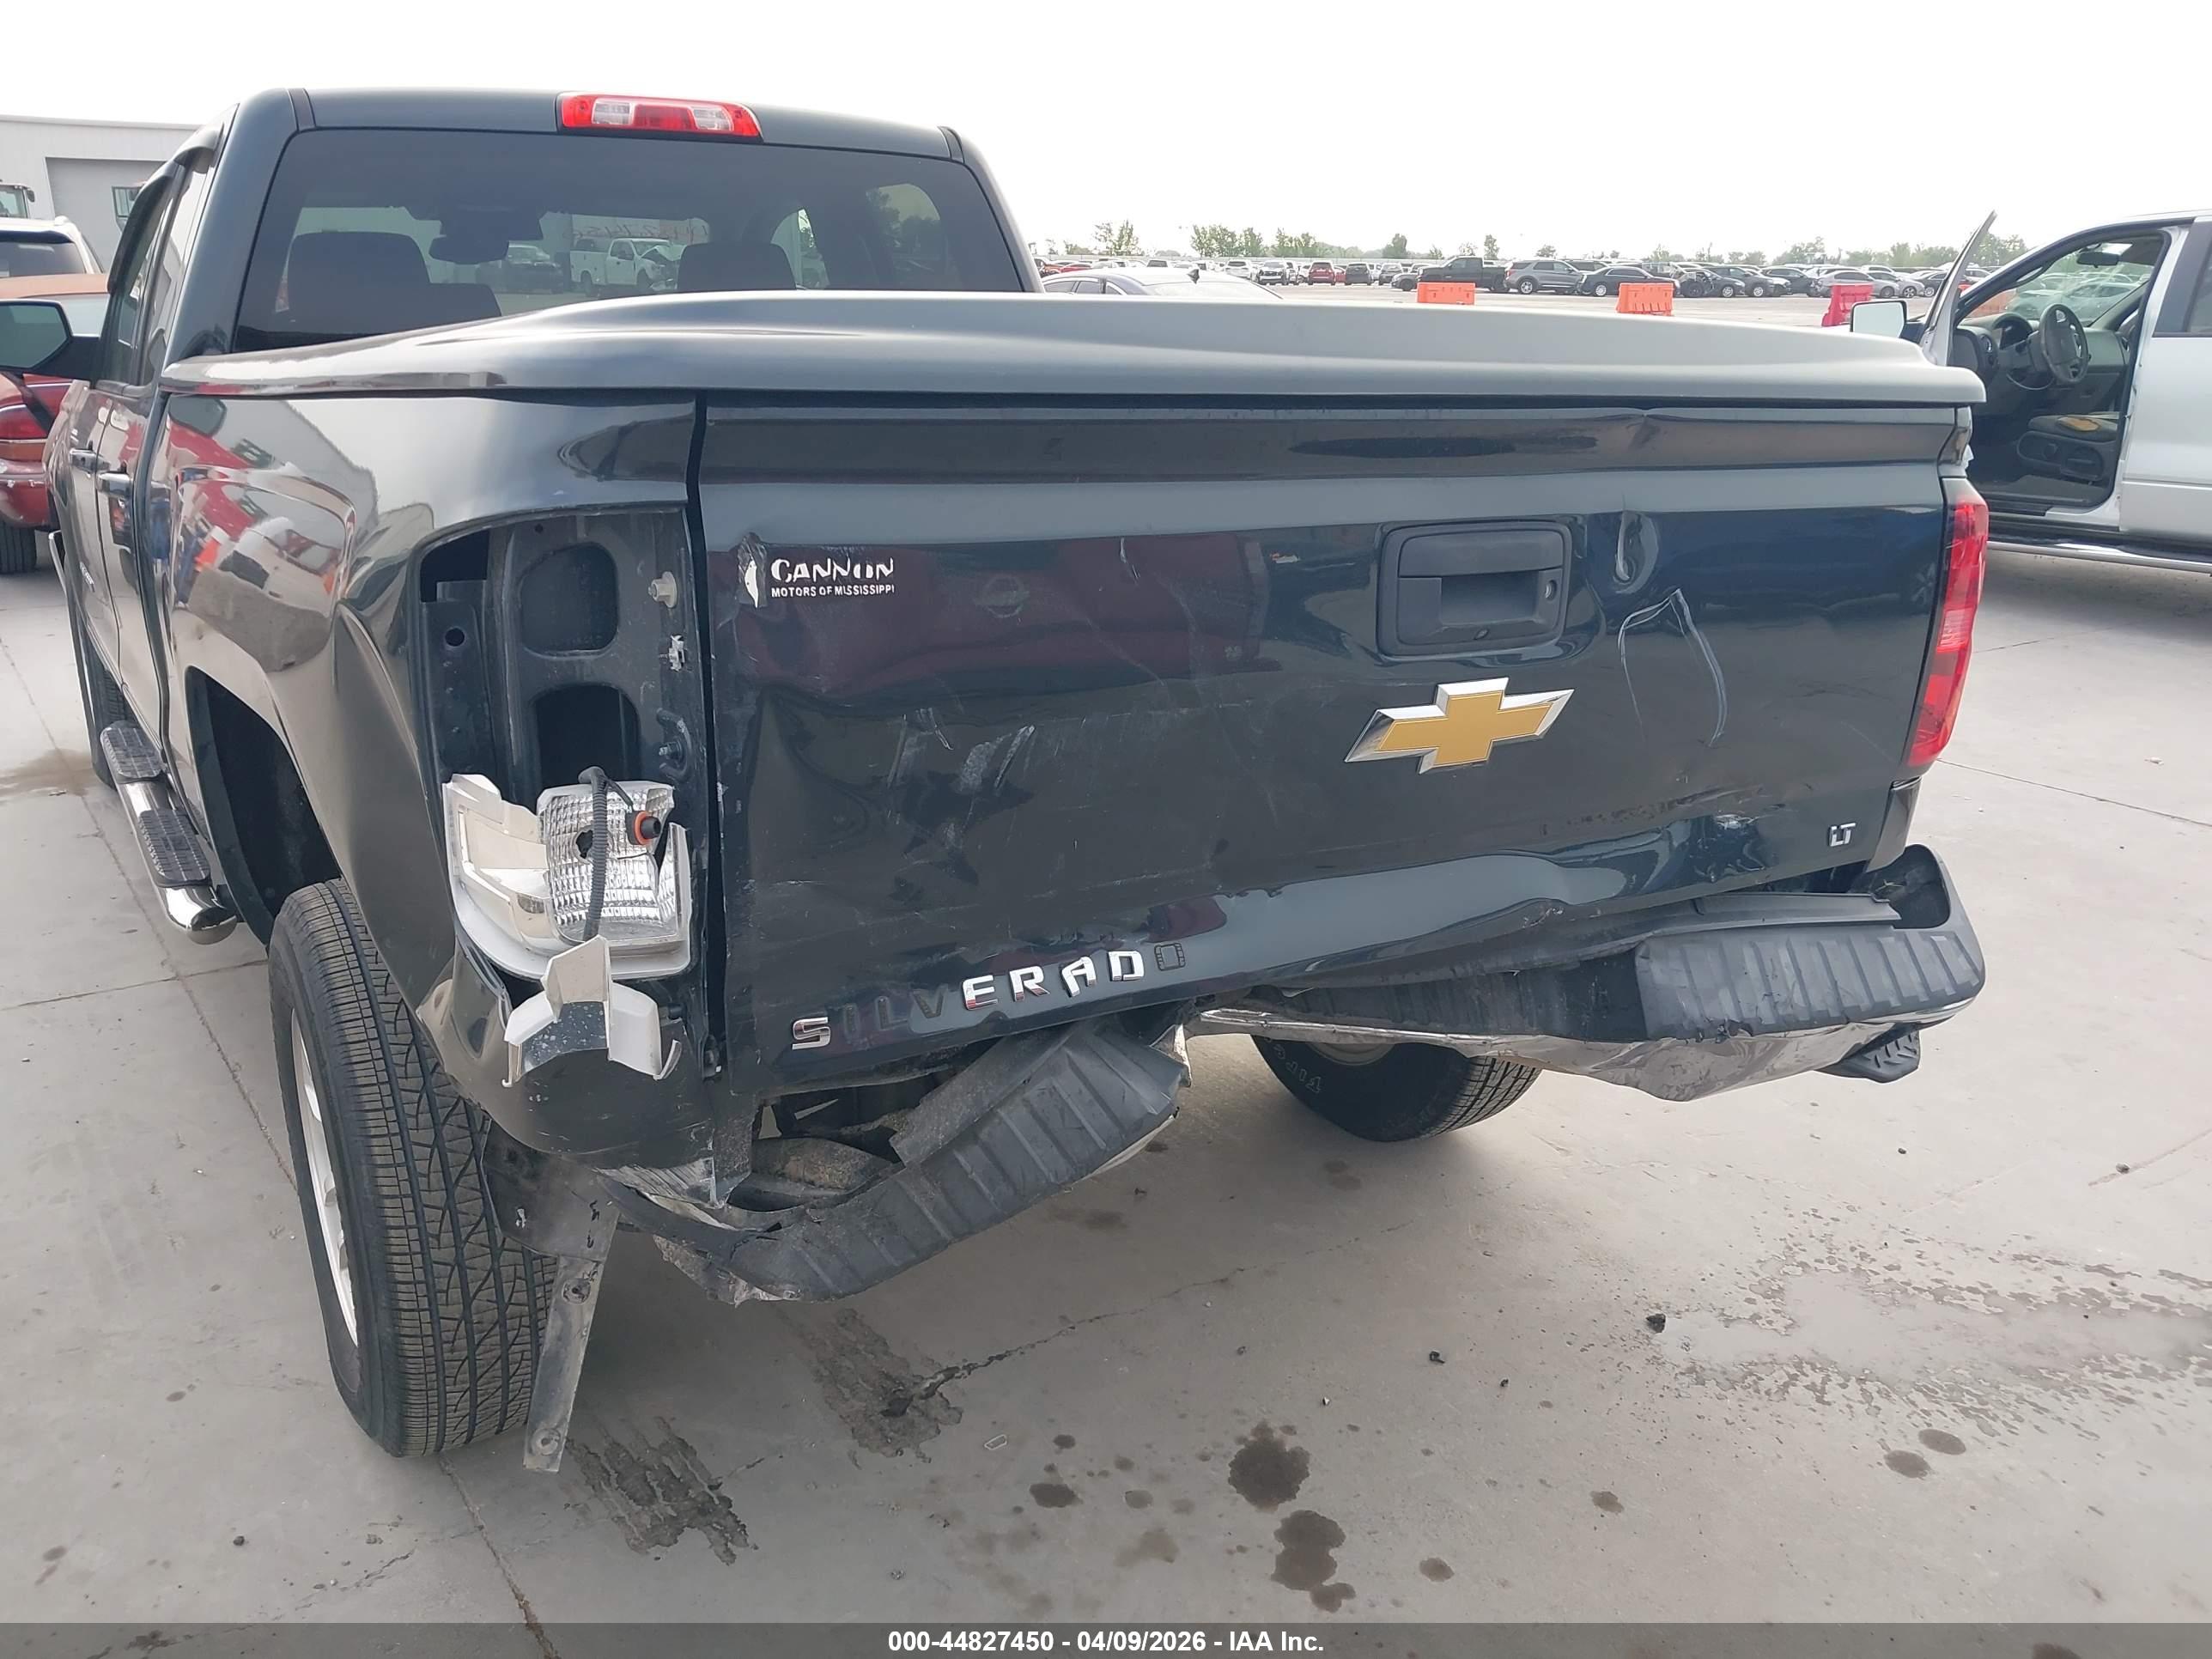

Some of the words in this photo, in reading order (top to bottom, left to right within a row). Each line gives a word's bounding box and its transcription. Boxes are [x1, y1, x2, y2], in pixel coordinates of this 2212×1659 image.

[771, 586, 816, 598] MOTORS
[819, 586, 832, 596] OF
[835, 585, 895, 597] MISSISSIPPI
[1829, 822, 1856, 847] LT
